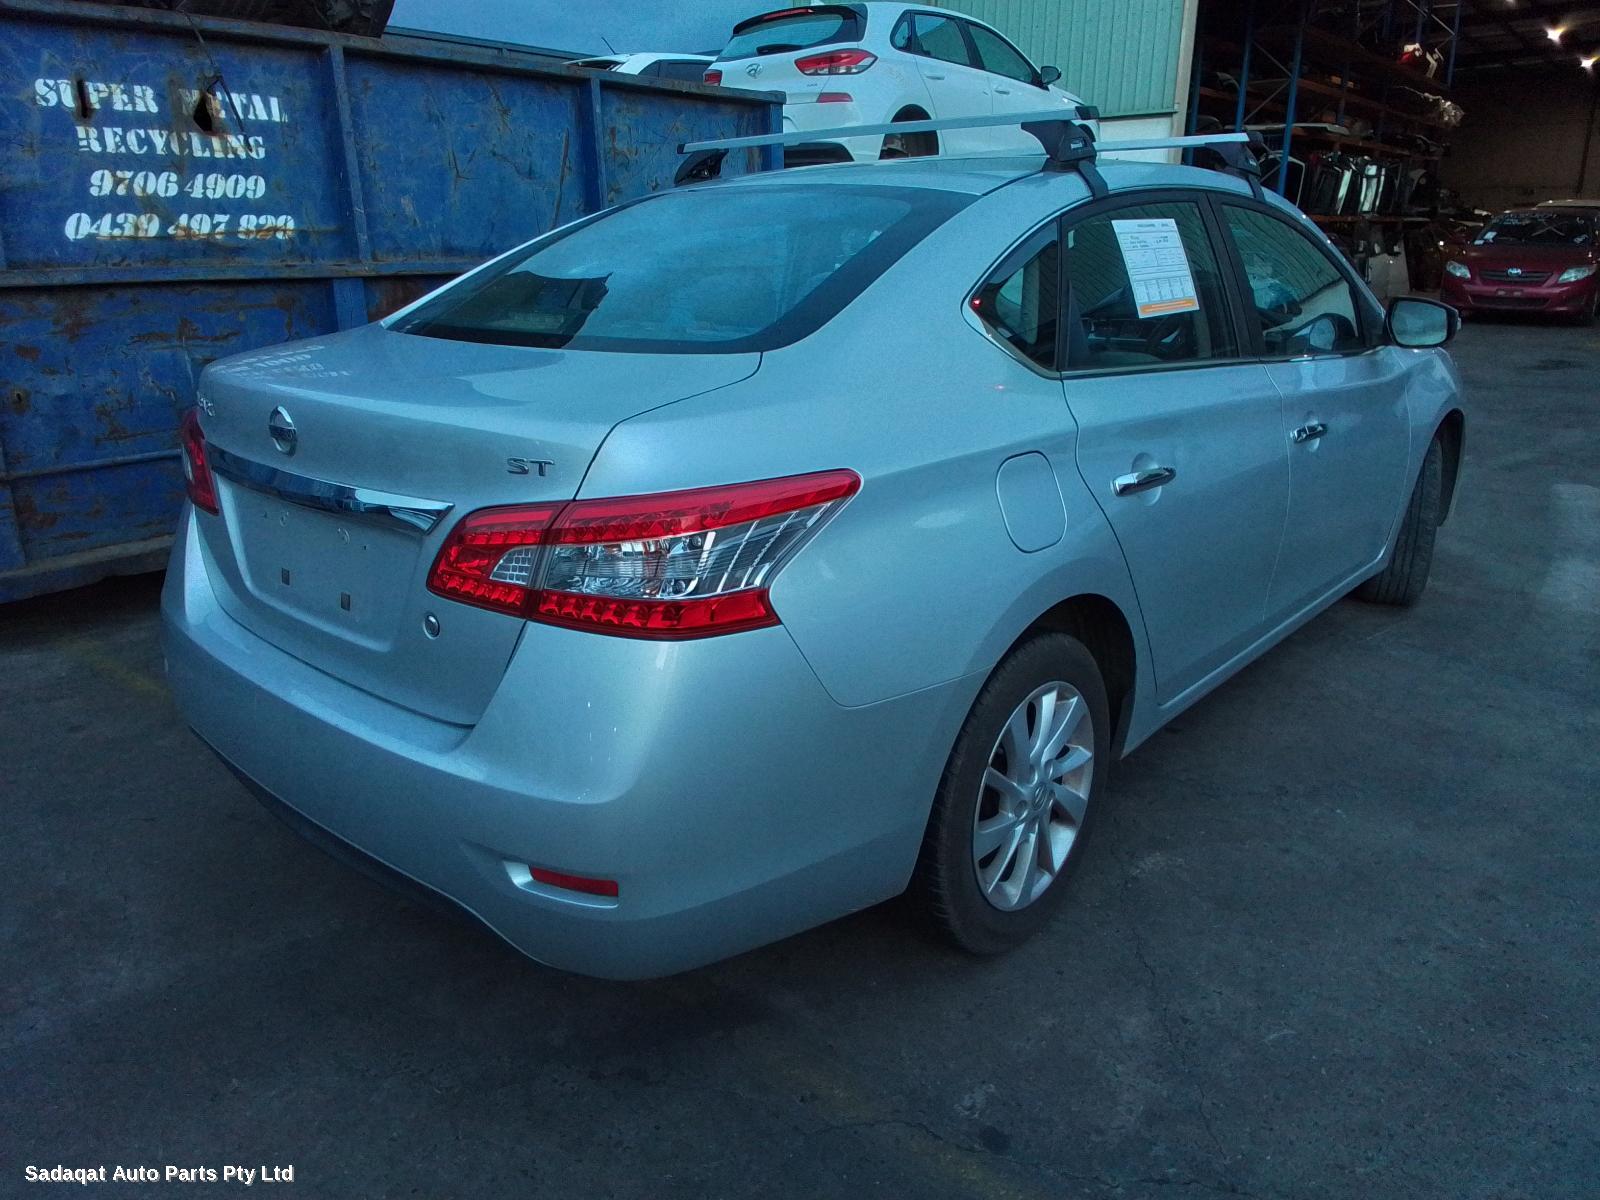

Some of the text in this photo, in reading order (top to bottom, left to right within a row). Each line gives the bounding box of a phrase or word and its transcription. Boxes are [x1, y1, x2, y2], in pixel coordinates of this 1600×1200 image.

[34, 78, 159, 113] SUPER
[76, 126, 266, 160] RECYCLING
[90, 169, 266, 199] 9706 4909
[65, 212, 160, 241] 0439
[167, 213, 230, 240] 497
[507, 457, 555, 476] ST
